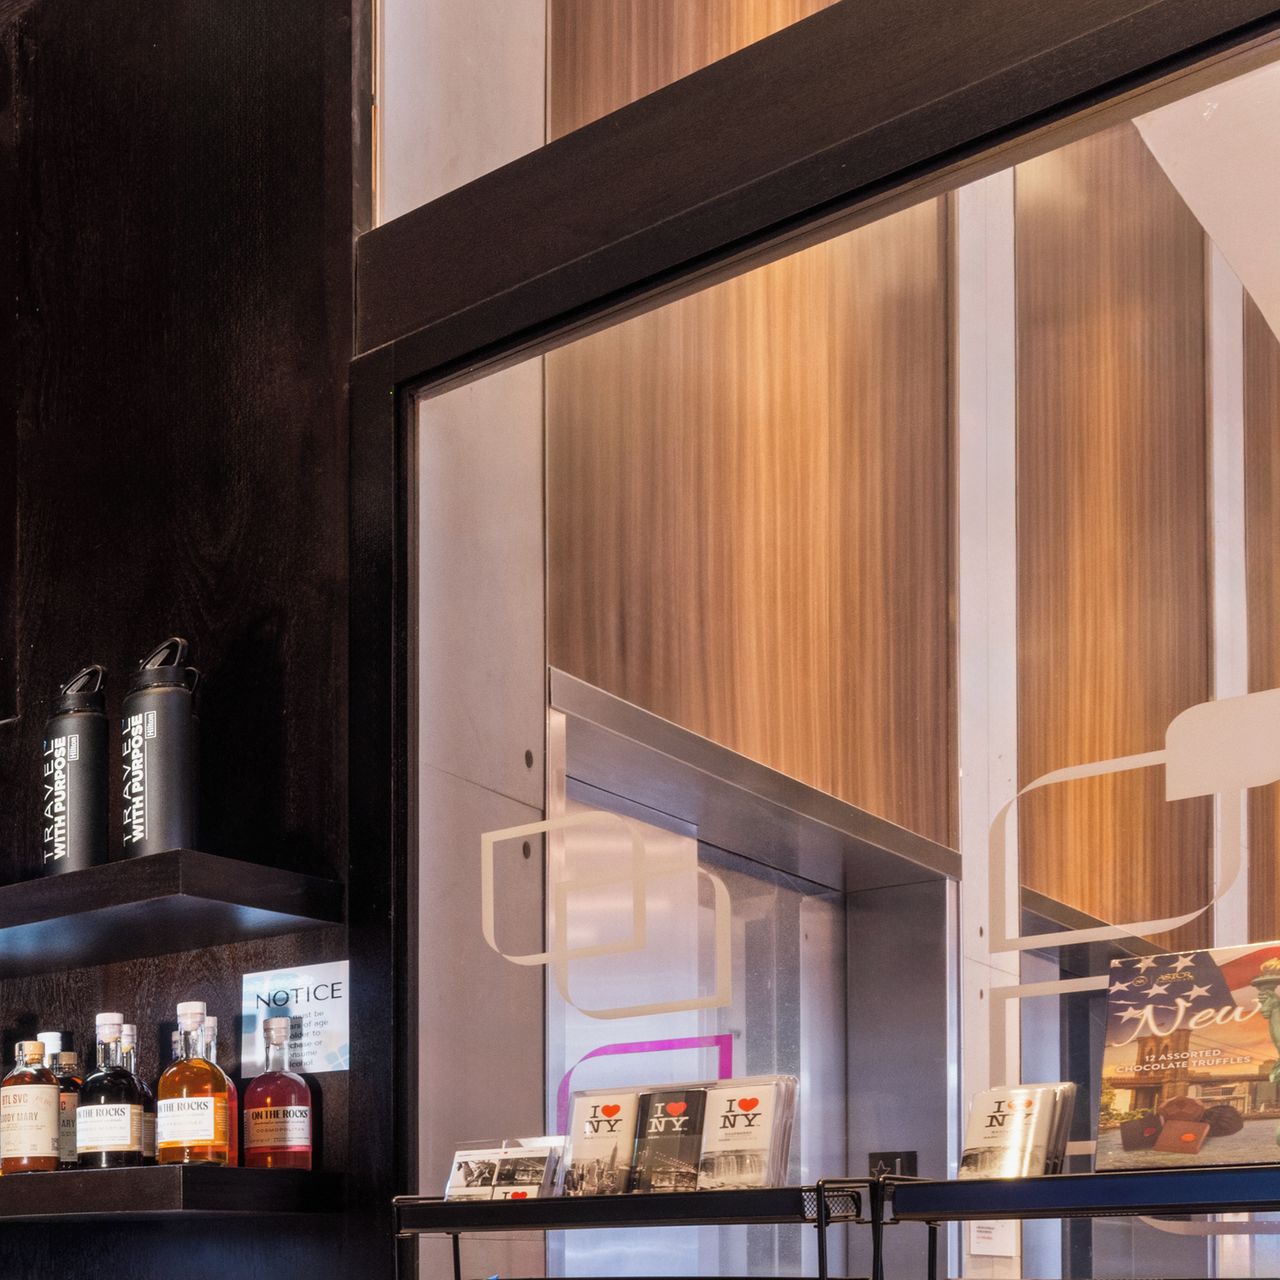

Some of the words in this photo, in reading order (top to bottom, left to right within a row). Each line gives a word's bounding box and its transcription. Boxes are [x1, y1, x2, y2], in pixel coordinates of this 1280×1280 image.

[132, 713, 144, 791] PURPOSE
[54, 736, 66, 807] PURPOSE
[122, 717, 132, 847] TRAVEL
[44, 740, 53, 864] TRAVEL
[132, 793, 144, 843] WITH
[54, 810, 66, 860] WITH
[256, 981, 343, 1009] NOTICE
[314, 1010, 324, 1018] be
[314, 1020, 329, 1029] age
[1112, 998, 1262, 1047] New
[312, 1029, 321, 1037] to
[1144, 1052, 1156, 1063] 12
[1158, 1048, 1222, 1061] ASSORTED
[1115, 1061, 1188, 1074] CHOCOLATE
[1190, 1055, 1251, 1069] TRUFFLES
[12, 1094, 29, 1105] SVC
[177, 1101, 208, 1111] ROCKS
[16, 1111, 38, 1122] MARY
[95, 1107, 126, 1117] ROCKS
[252, 1111, 263, 1120] ON
[265, 1110, 281, 1119] THE
[283, 1109, 308, 1119] ROCKS
[584, 1119, 623, 1134] NY
[648, 1117, 689, 1133] NY
[720, 1113, 762, 1129] NY
